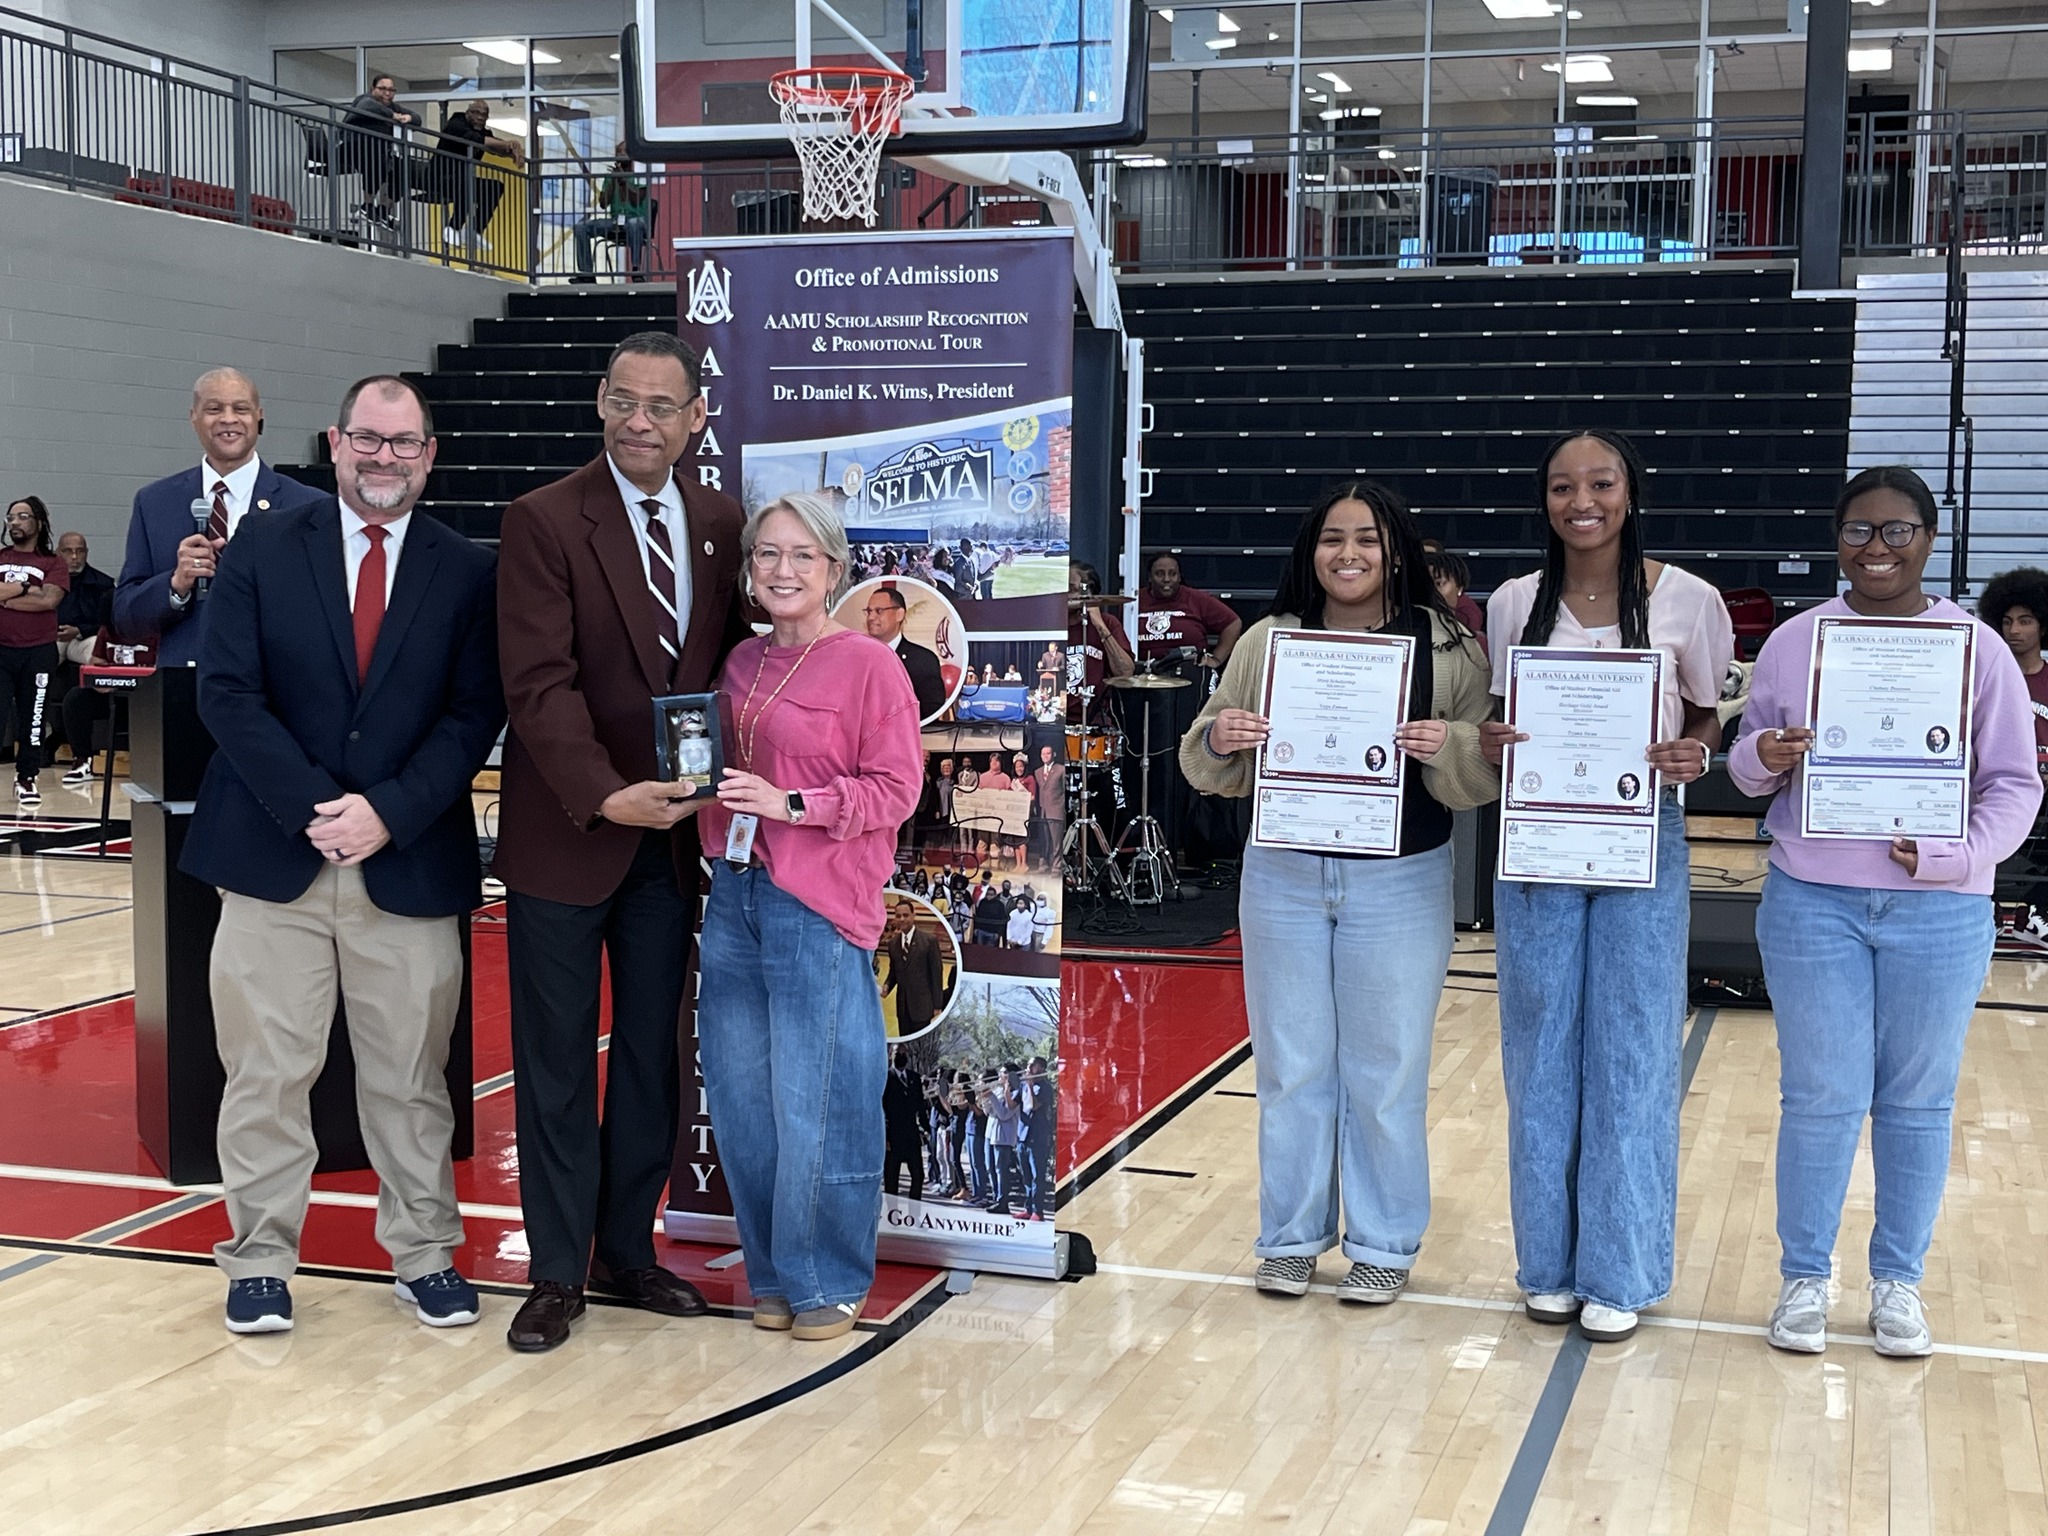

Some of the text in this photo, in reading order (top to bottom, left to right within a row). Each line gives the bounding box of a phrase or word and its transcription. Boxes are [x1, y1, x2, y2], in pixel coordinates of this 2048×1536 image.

[796, 265, 998, 287] Office of Admissions
[764, 313, 821, 329] AAMU
[812, 336, 827, 352] &
[774, 383, 1014, 401] Dr. Daniel K. Wims, President
[882, 453, 966, 478] WELCOME TO HISTORIC
[869, 461, 985, 516] SELMA
[1166, 632, 1183, 640] BEAT
[1830, 635, 1876, 643] ALABAMA
[1901, 637, 1957, 646] UNIVERSITY
[1283, 650, 1322, 659] ALABAMA
[1346, 654, 1395, 663] UNIVERSITY
[94, 678, 137, 687] nord piano 5
[1524, 671, 1644, 683] ALABAMA A&M UNIVERSITY
